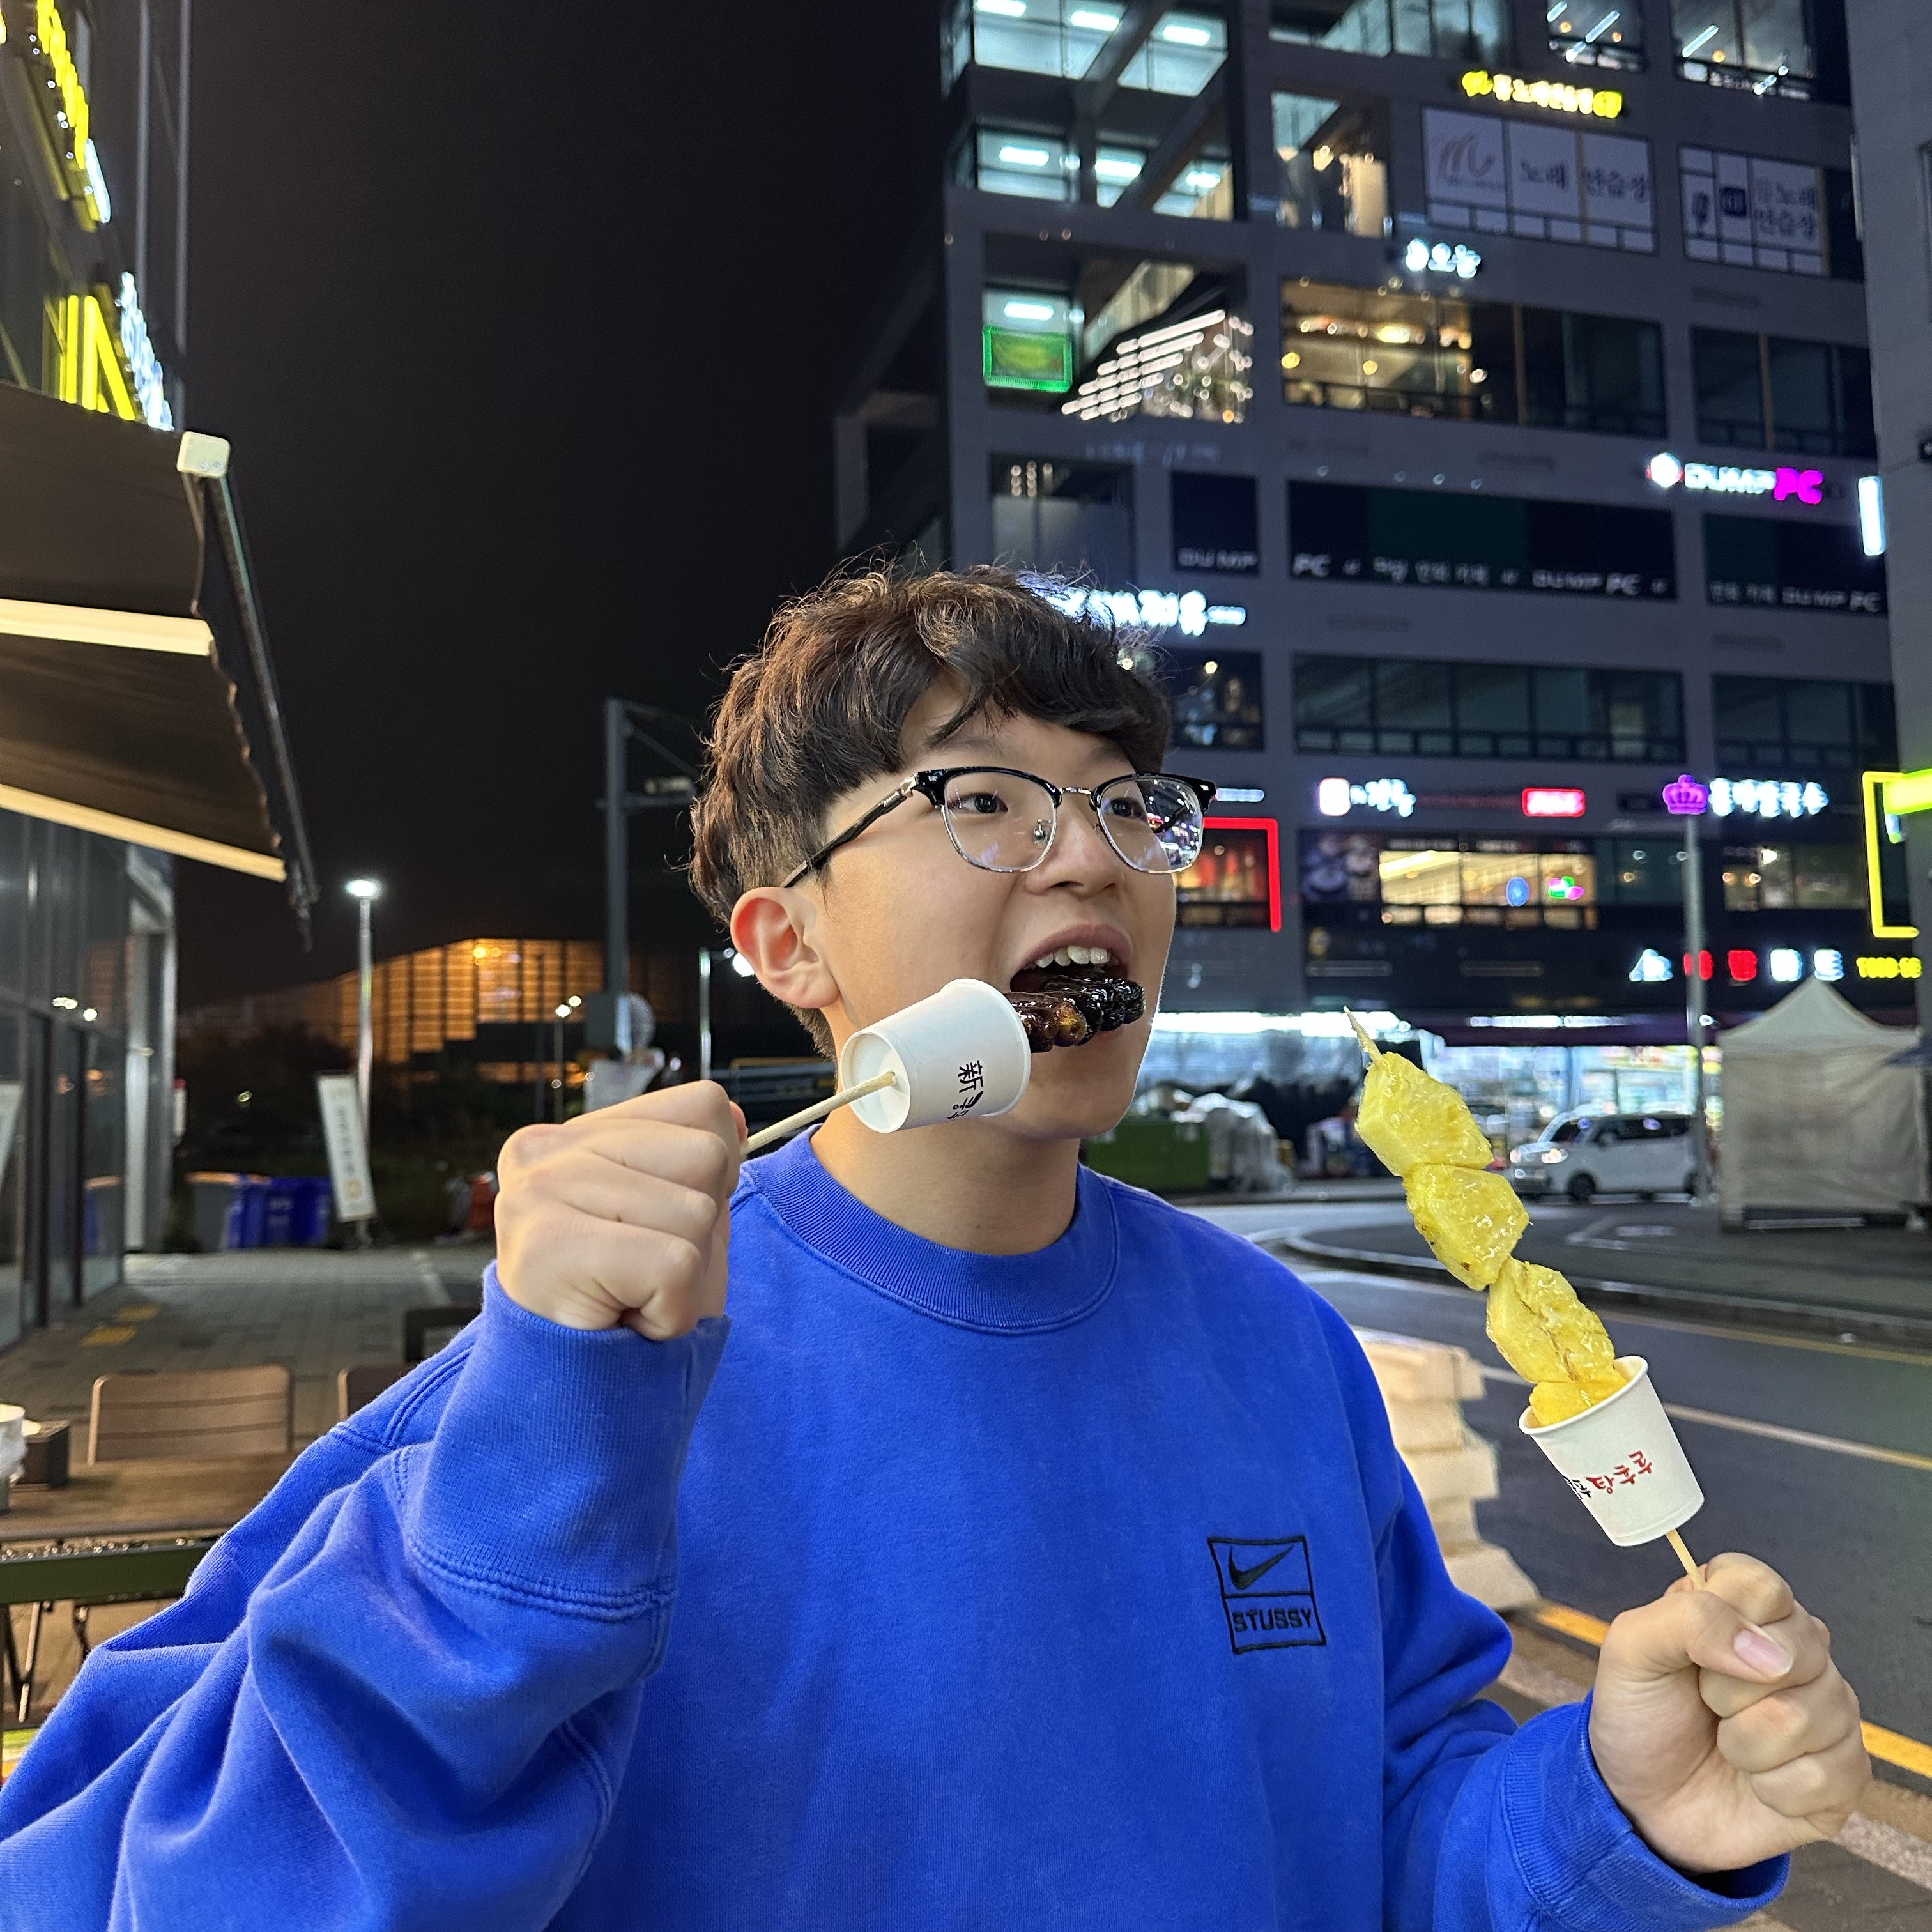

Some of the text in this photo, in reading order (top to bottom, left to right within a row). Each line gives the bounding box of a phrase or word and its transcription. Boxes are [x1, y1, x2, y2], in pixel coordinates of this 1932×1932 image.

[1292, 552, 1332, 576] PC
[1605, 572, 1642, 596] PC
[1232, 1609, 1311, 1632] STUSSY
